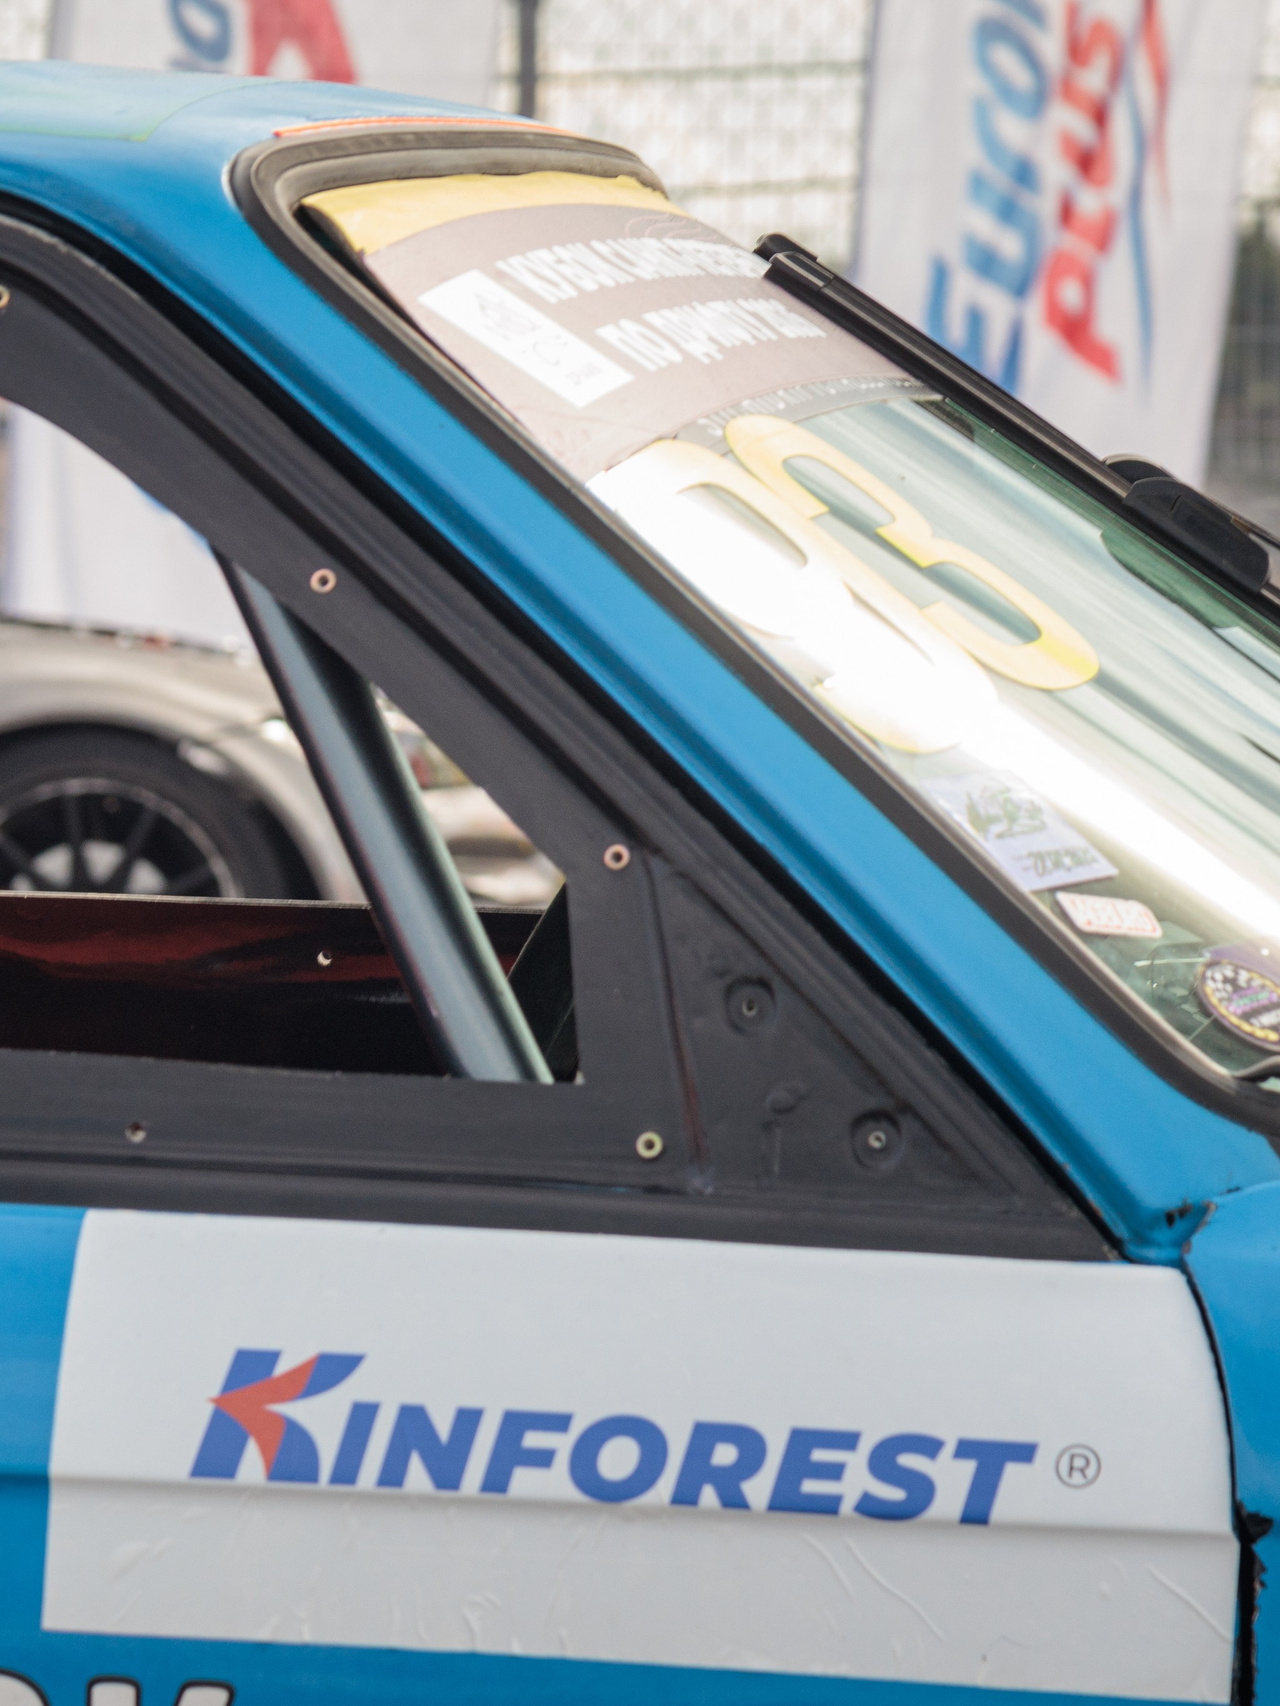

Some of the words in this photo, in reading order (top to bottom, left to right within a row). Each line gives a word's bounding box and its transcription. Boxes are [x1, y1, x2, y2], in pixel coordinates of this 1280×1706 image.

[926, 0, 1048, 402] Euro
[595, 318, 684, 372] ПО
[189, 1348, 1039, 1527] KINFOREST
